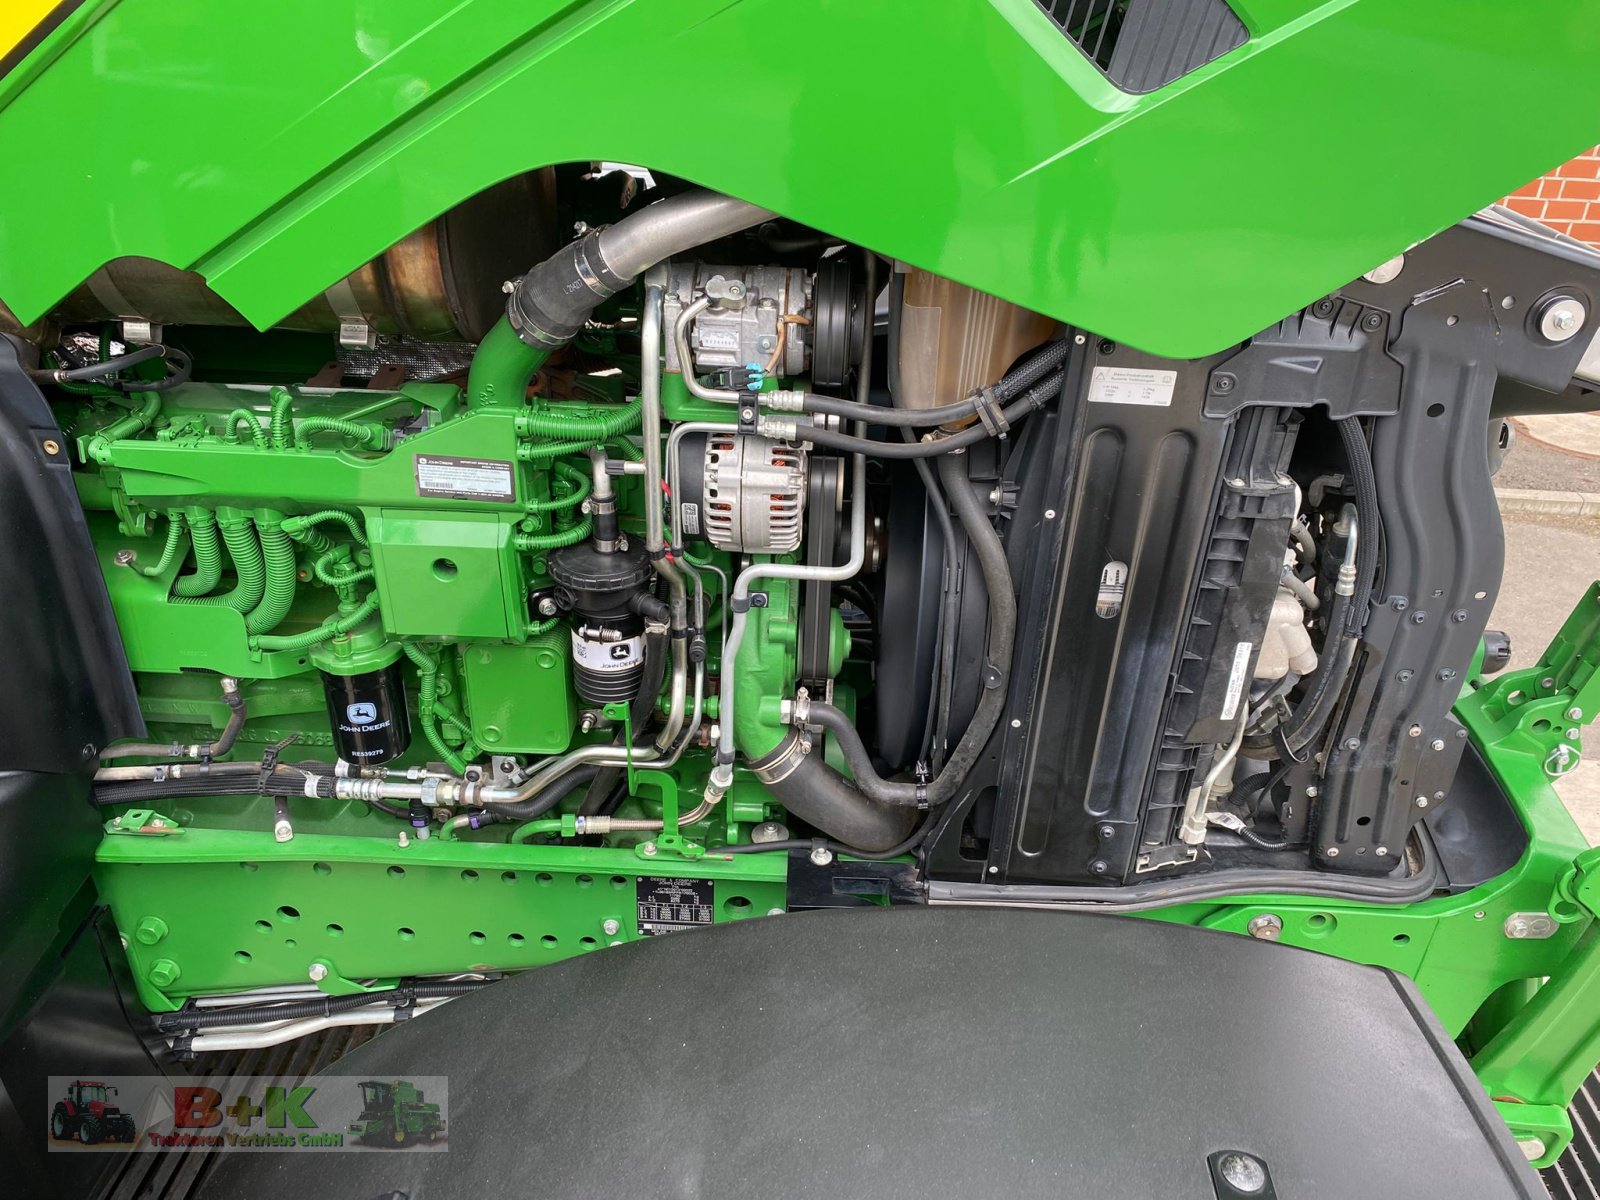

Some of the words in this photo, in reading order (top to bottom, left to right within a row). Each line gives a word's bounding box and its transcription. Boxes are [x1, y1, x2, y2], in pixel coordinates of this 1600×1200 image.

[619, 658, 639, 668] DEERE
[339, 724, 361, 732] JOHN
[361, 720, 391, 732] DEERE
[351, 749, 384, 757] RE539279
